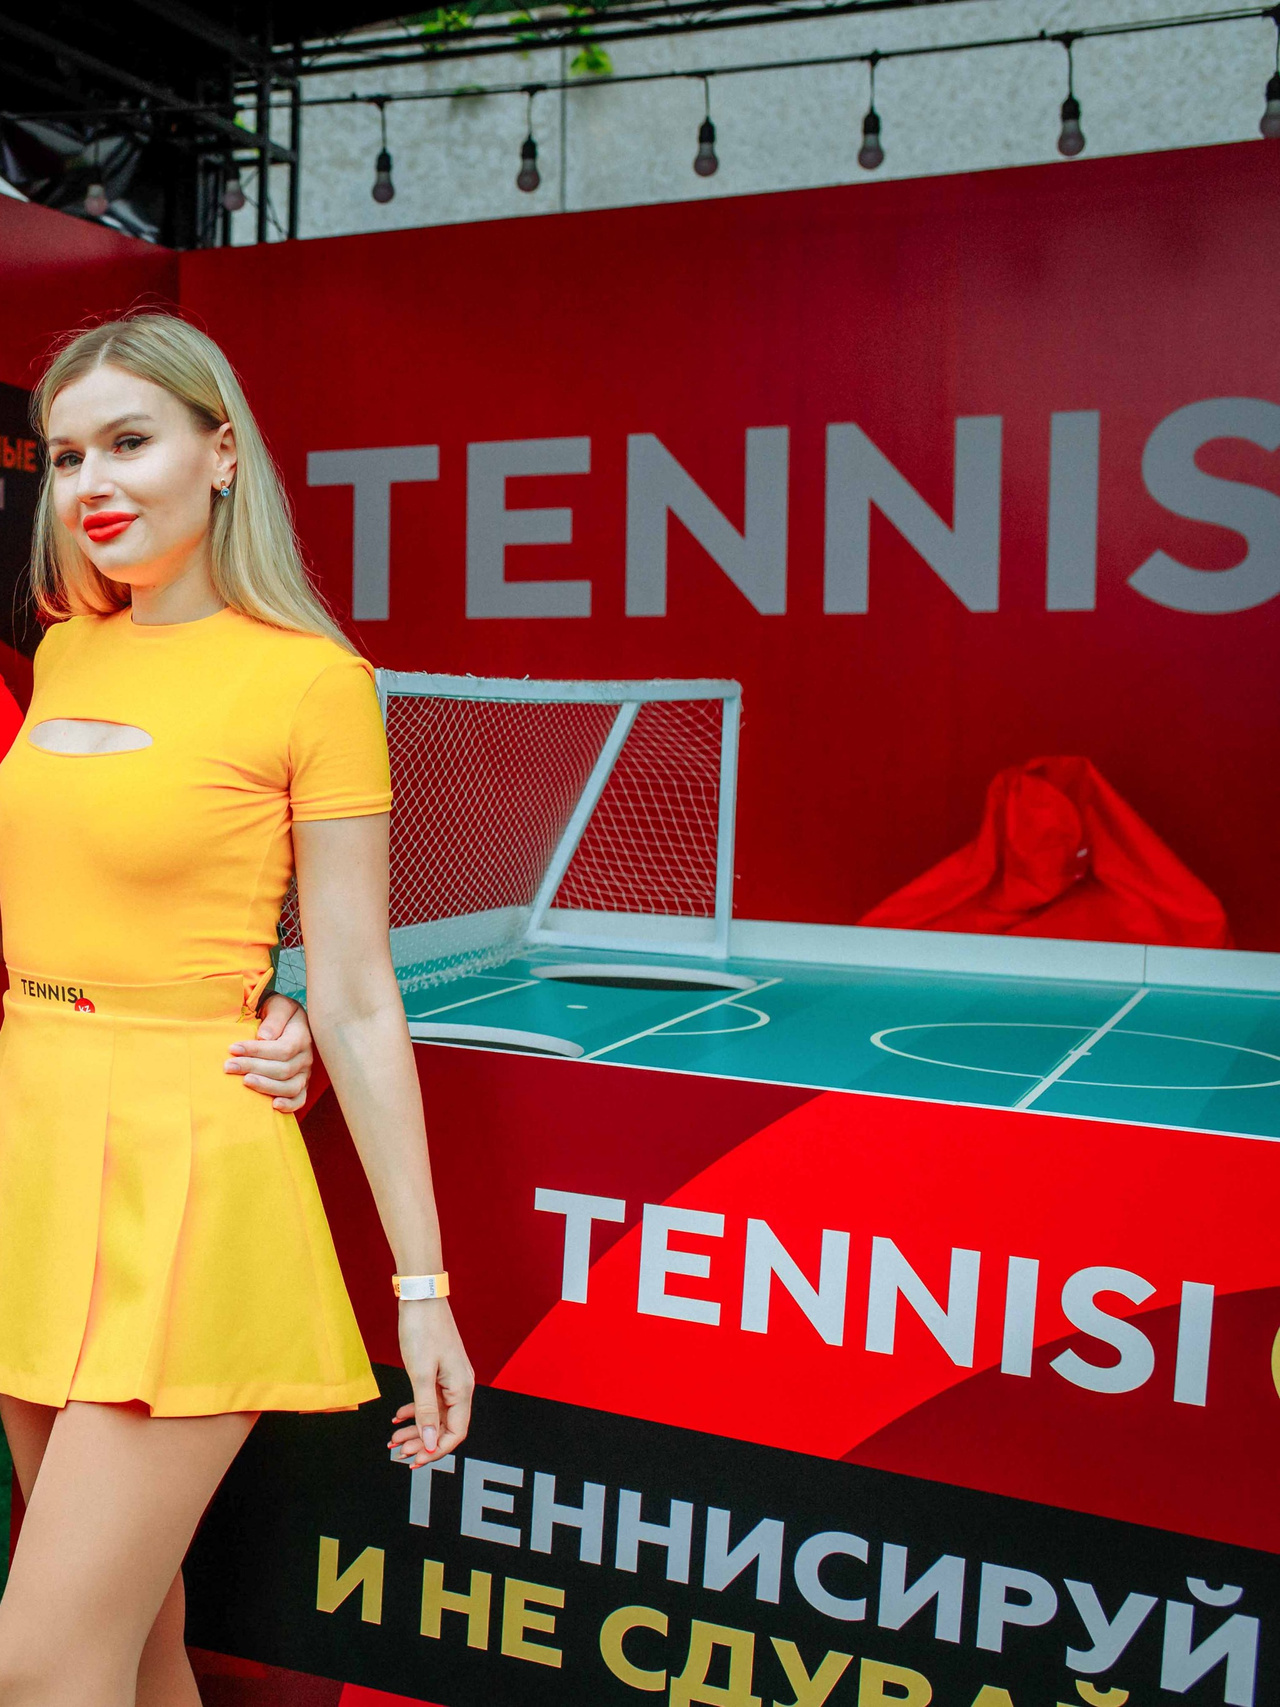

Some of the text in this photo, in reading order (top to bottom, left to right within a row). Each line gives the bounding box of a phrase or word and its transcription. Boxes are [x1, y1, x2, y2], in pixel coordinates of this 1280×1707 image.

[306, 396, 1280, 621] TENNIS
[21, 978, 84, 1004] TENNISI
[534, 1187, 1215, 1407] TENNISI
[317, 1535, 1129, 1707] И НЕ СДУВ
[389, 1444, 1260, 1707] ТЕННИСИРУЙ
